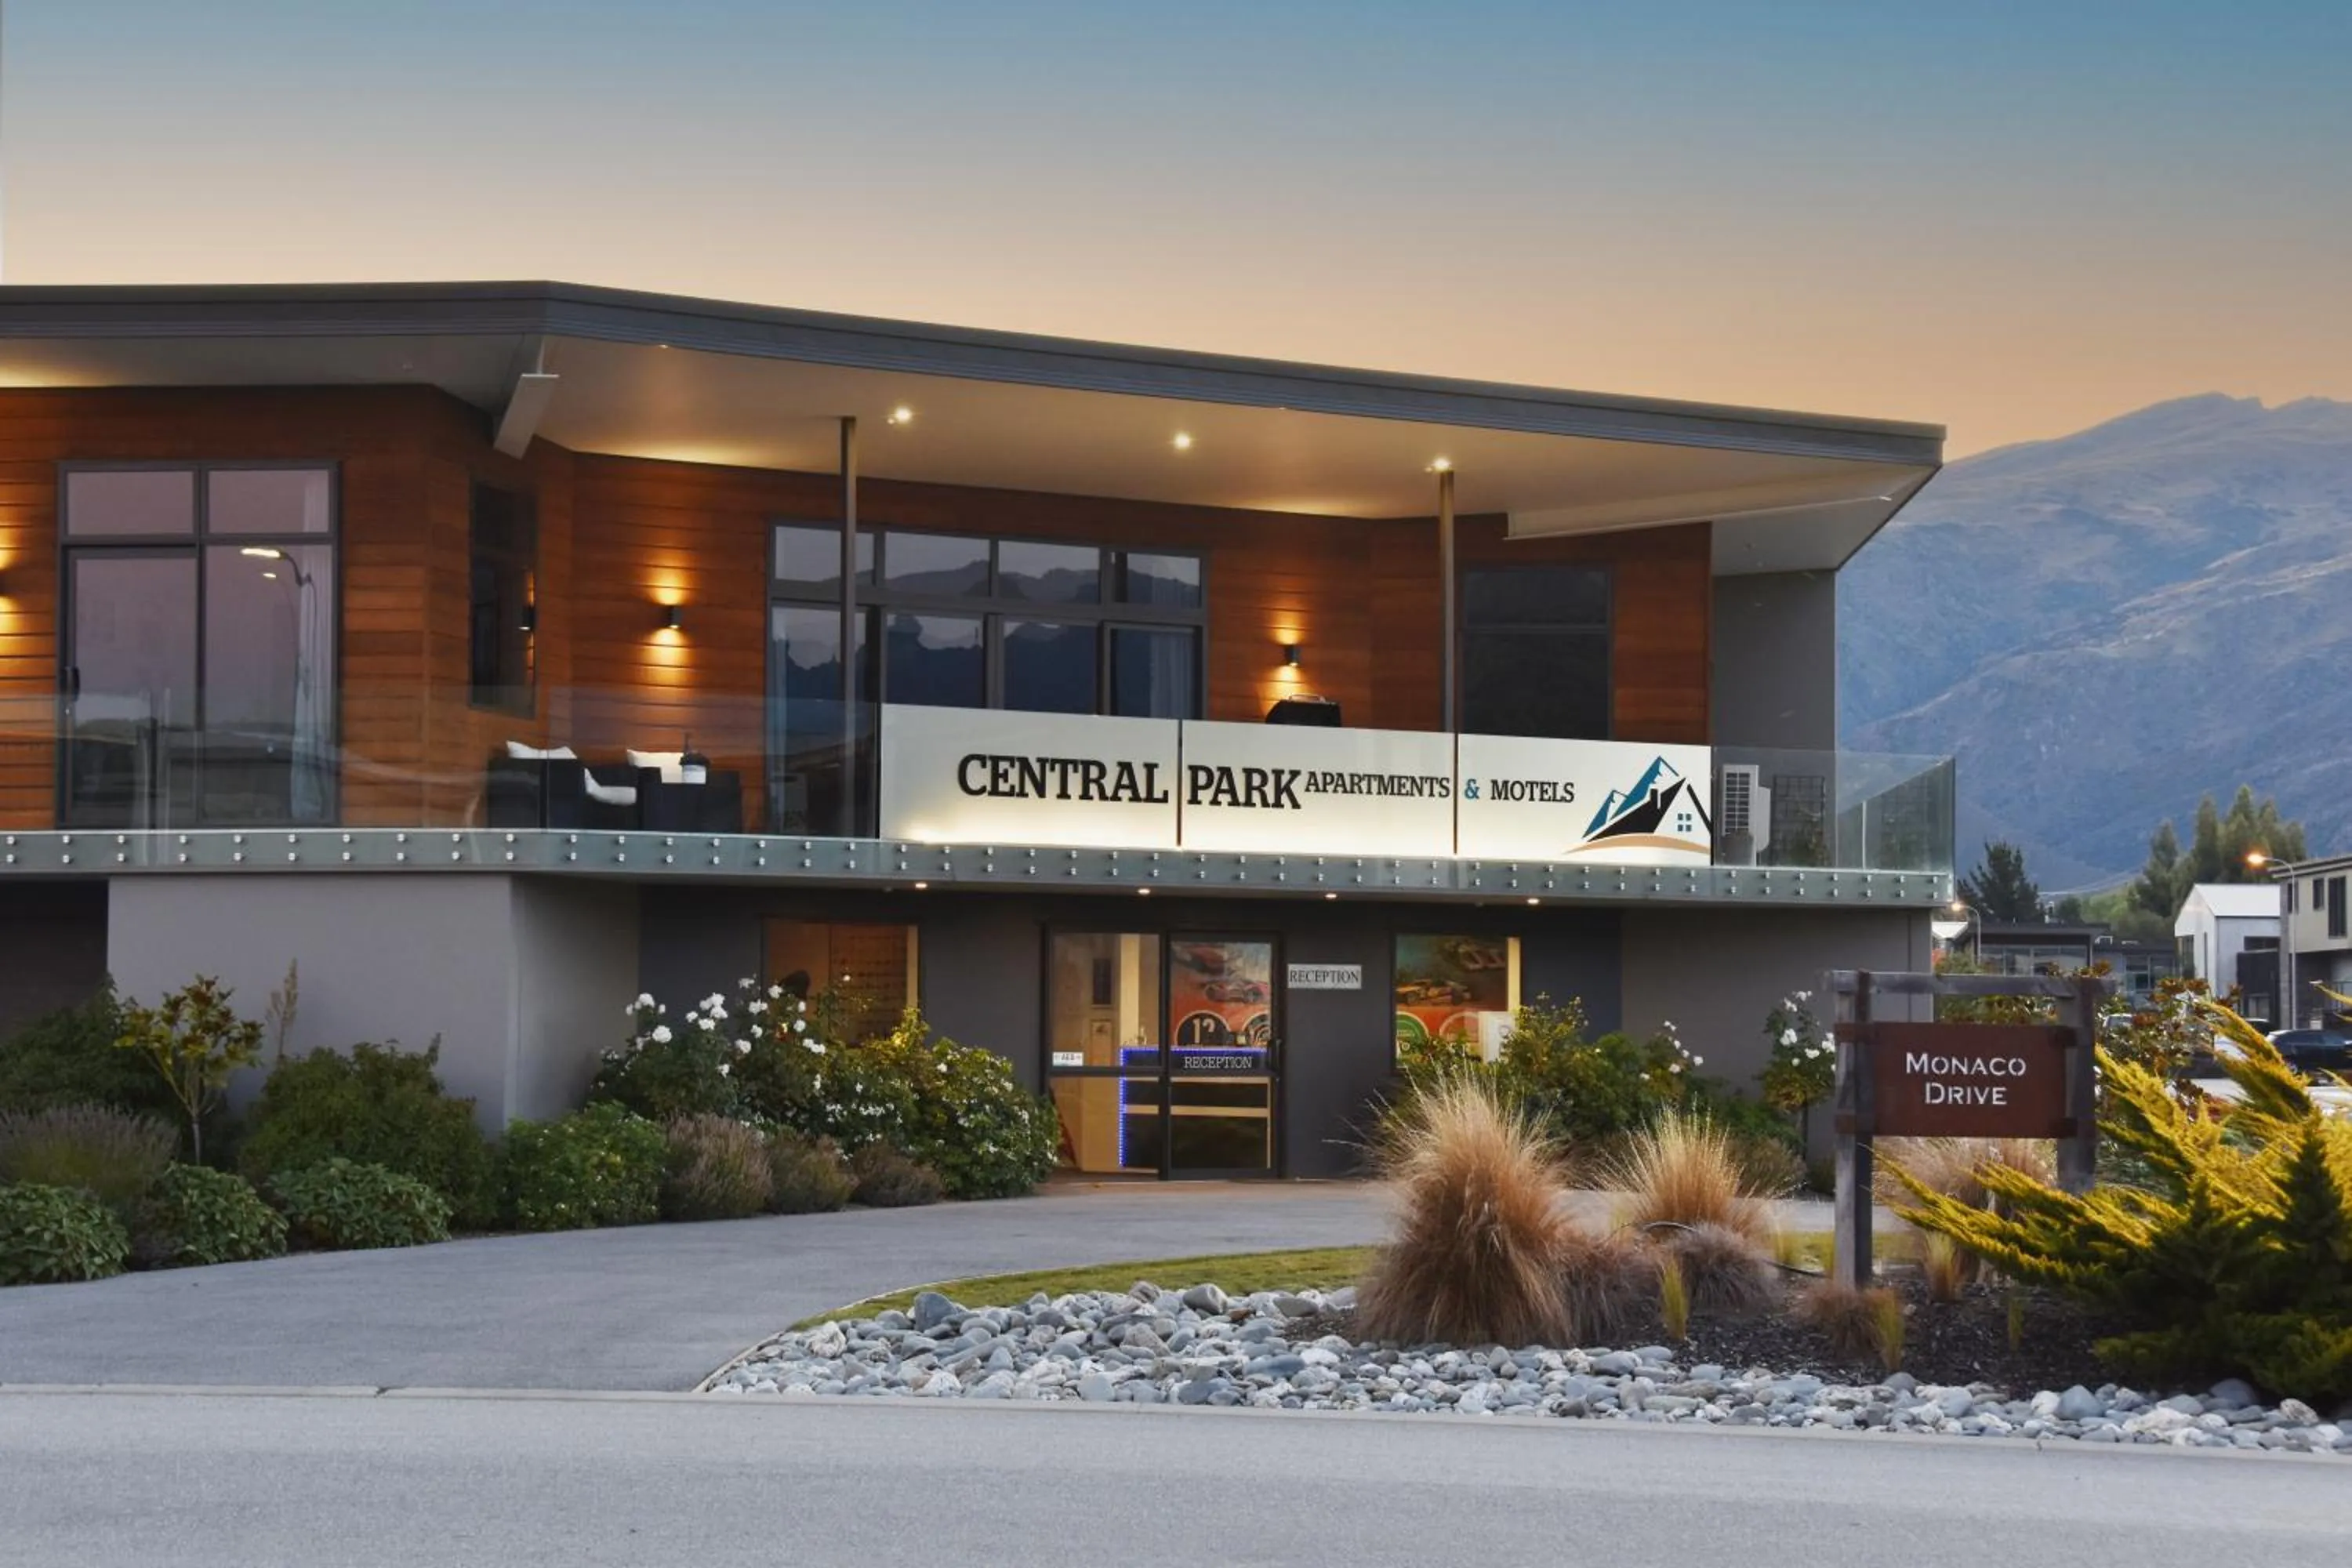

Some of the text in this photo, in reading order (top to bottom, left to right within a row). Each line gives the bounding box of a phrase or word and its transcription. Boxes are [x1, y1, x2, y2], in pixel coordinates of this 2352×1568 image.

[958, 753, 1575, 810] CENTRAL PARK APARTMENTS & MOTELS
[1290, 970, 1359, 984] RECEPTION
[1184, 1056, 1252, 1069] RECEPTION
